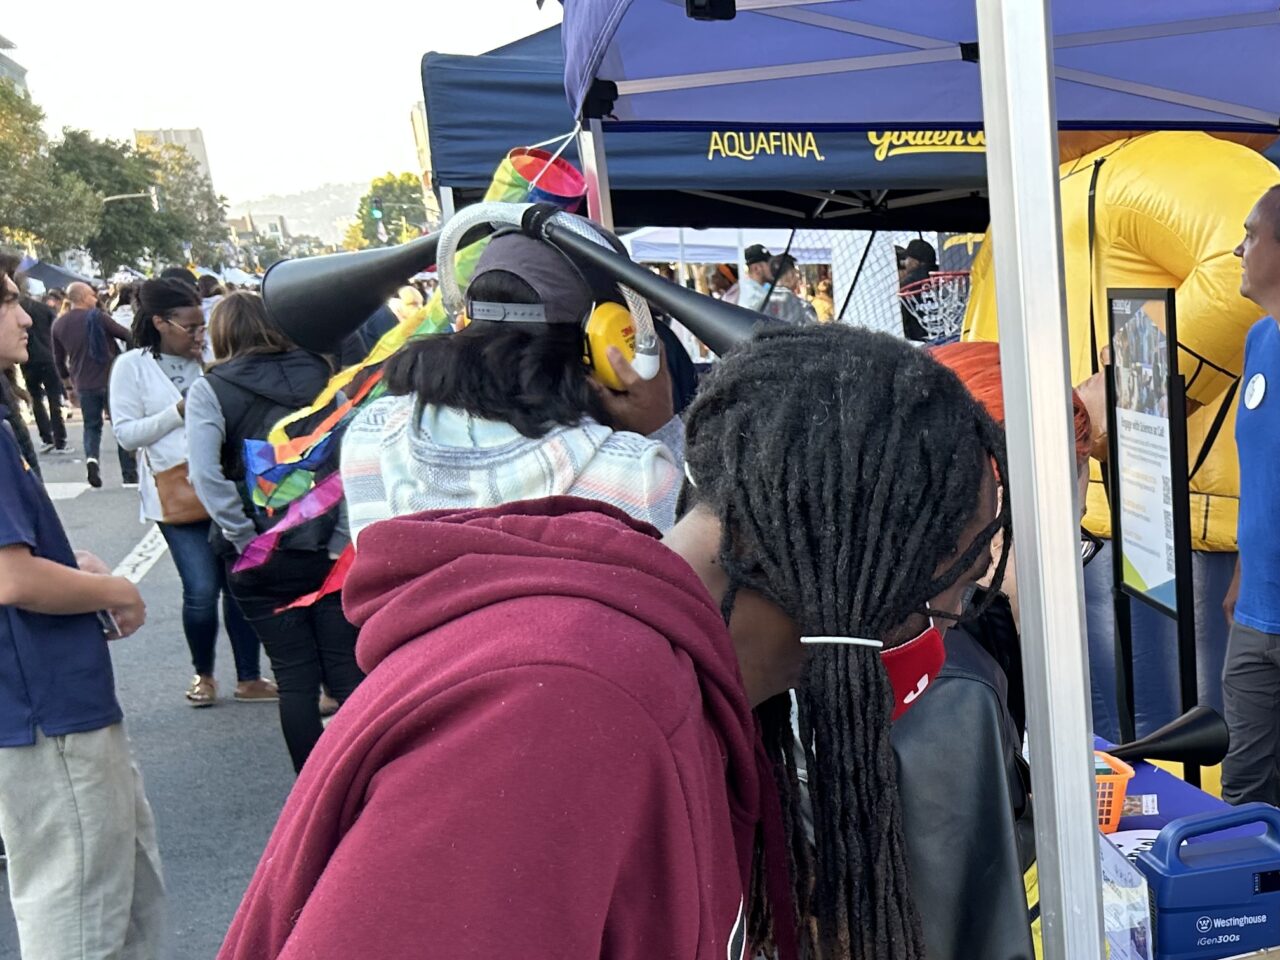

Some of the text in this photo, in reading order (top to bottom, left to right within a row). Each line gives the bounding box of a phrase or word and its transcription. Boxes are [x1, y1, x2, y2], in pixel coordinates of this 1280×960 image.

[707, 131, 821, 161] AQUAFINA
[1213, 913, 1267, 929] Westinghouse
[1197, 934, 1240, 946] iGen300s
